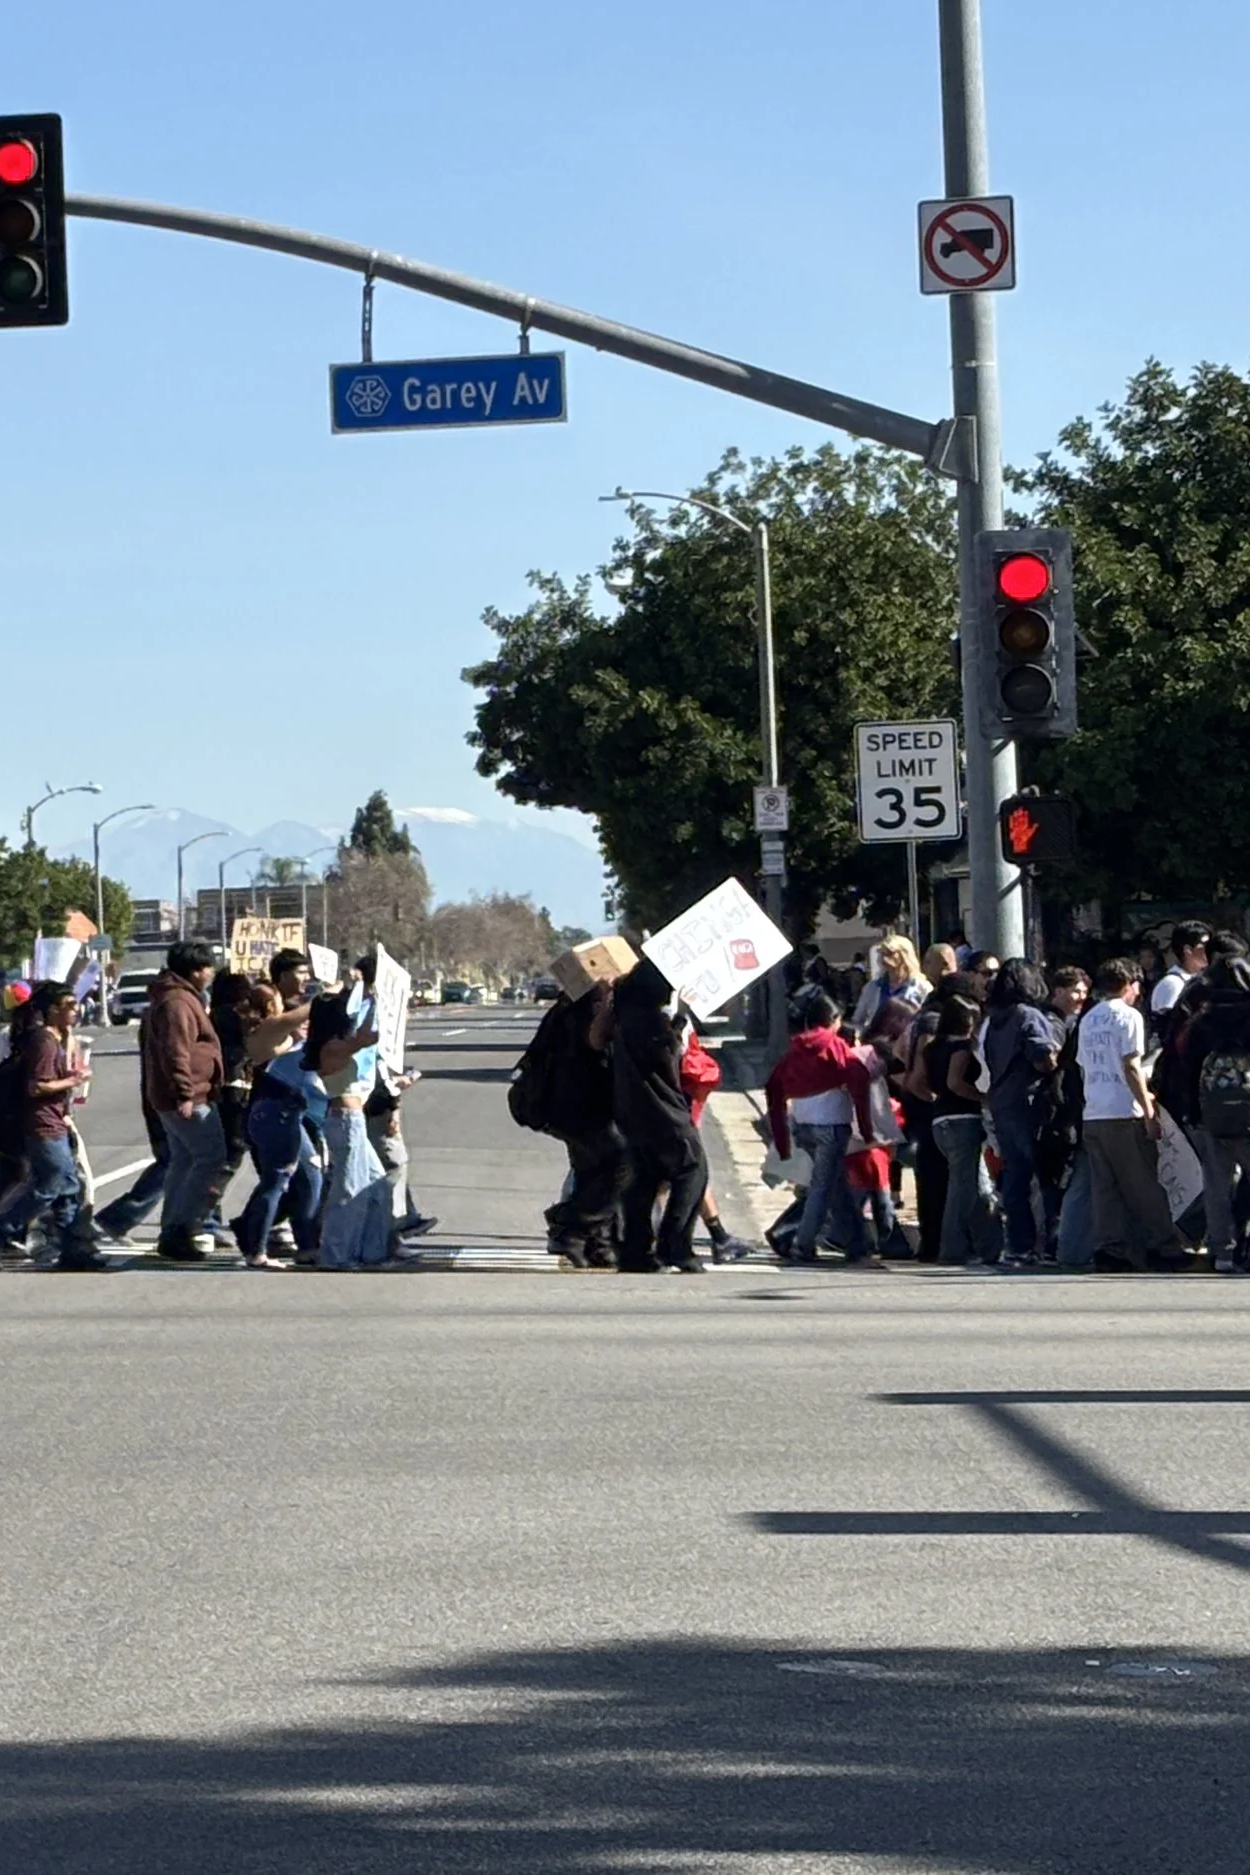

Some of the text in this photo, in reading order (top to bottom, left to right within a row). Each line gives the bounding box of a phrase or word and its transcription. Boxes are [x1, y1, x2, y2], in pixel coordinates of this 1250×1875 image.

[403, 371, 549, 416] Garey Av
[866, 731, 943, 751] SPEED
[876, 758, 937, 778] LIMIT
[874, 786, 946, 830] 35
[240, 921, 302, 942] HONK IF
[235, 940, 247, 957] U
